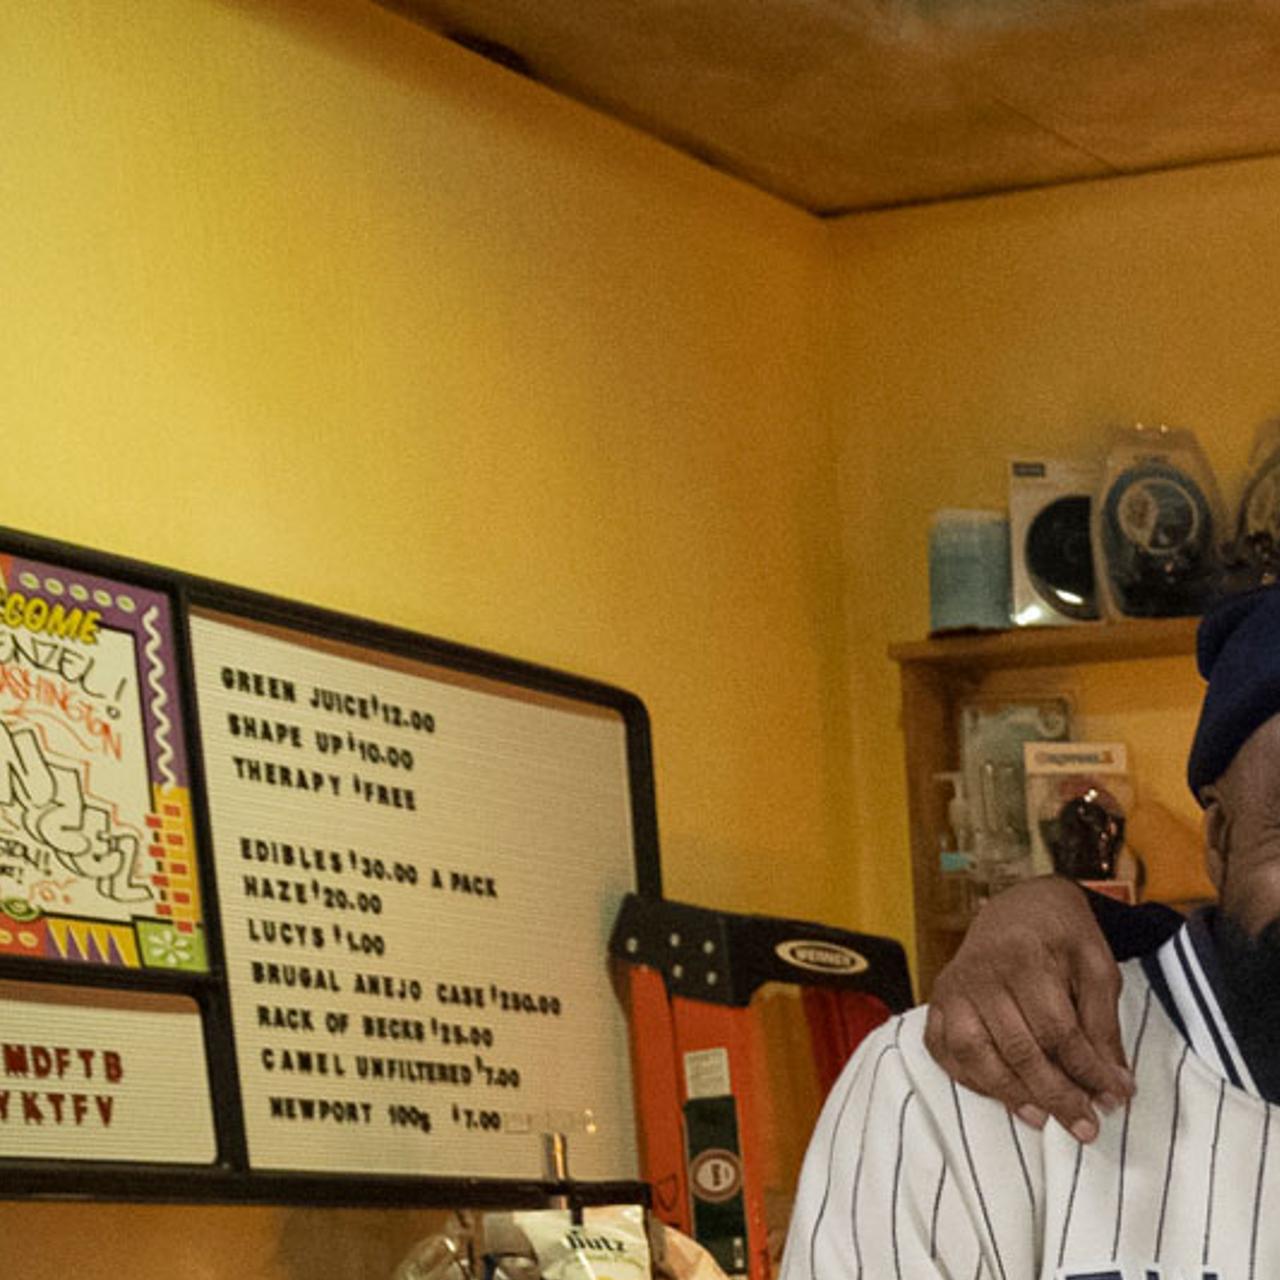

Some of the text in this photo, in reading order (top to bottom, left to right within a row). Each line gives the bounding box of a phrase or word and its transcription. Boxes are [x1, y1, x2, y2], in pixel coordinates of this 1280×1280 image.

[1, 591, 102, 645] COME
[221, 667, 296, 703] GREEN
[310, 688, 370, 720] JUICE
[228, 713, 302, 748] SHAPE
[315, 731, 343, 755] UP
[233, 756, 340, 796] THERAPY
[240, 837, 342, 874] EDIBLES
[431, 868, 443, 889] A
[450, 871, 498, 898] PACK
[243, 875, 307, 904] HAZE
[248, 918, 325, 948] LUCYS
[251, 961, 340, 992] BRUGAL
[354, 973, 422, 1001] ANEJO
[436, 983, 485, 1008] CASE
[257, 1004, 314, 1031] RACK
[325, 1012, 349, 1034] OF
[362, 1014, 425, 1042] BECKS
[261, 1048, 345, 1076] CAMEL
[356, 1055, 472, 1085] UNFILTERED
[269, 1096, 372, 1124] NEWPORT
